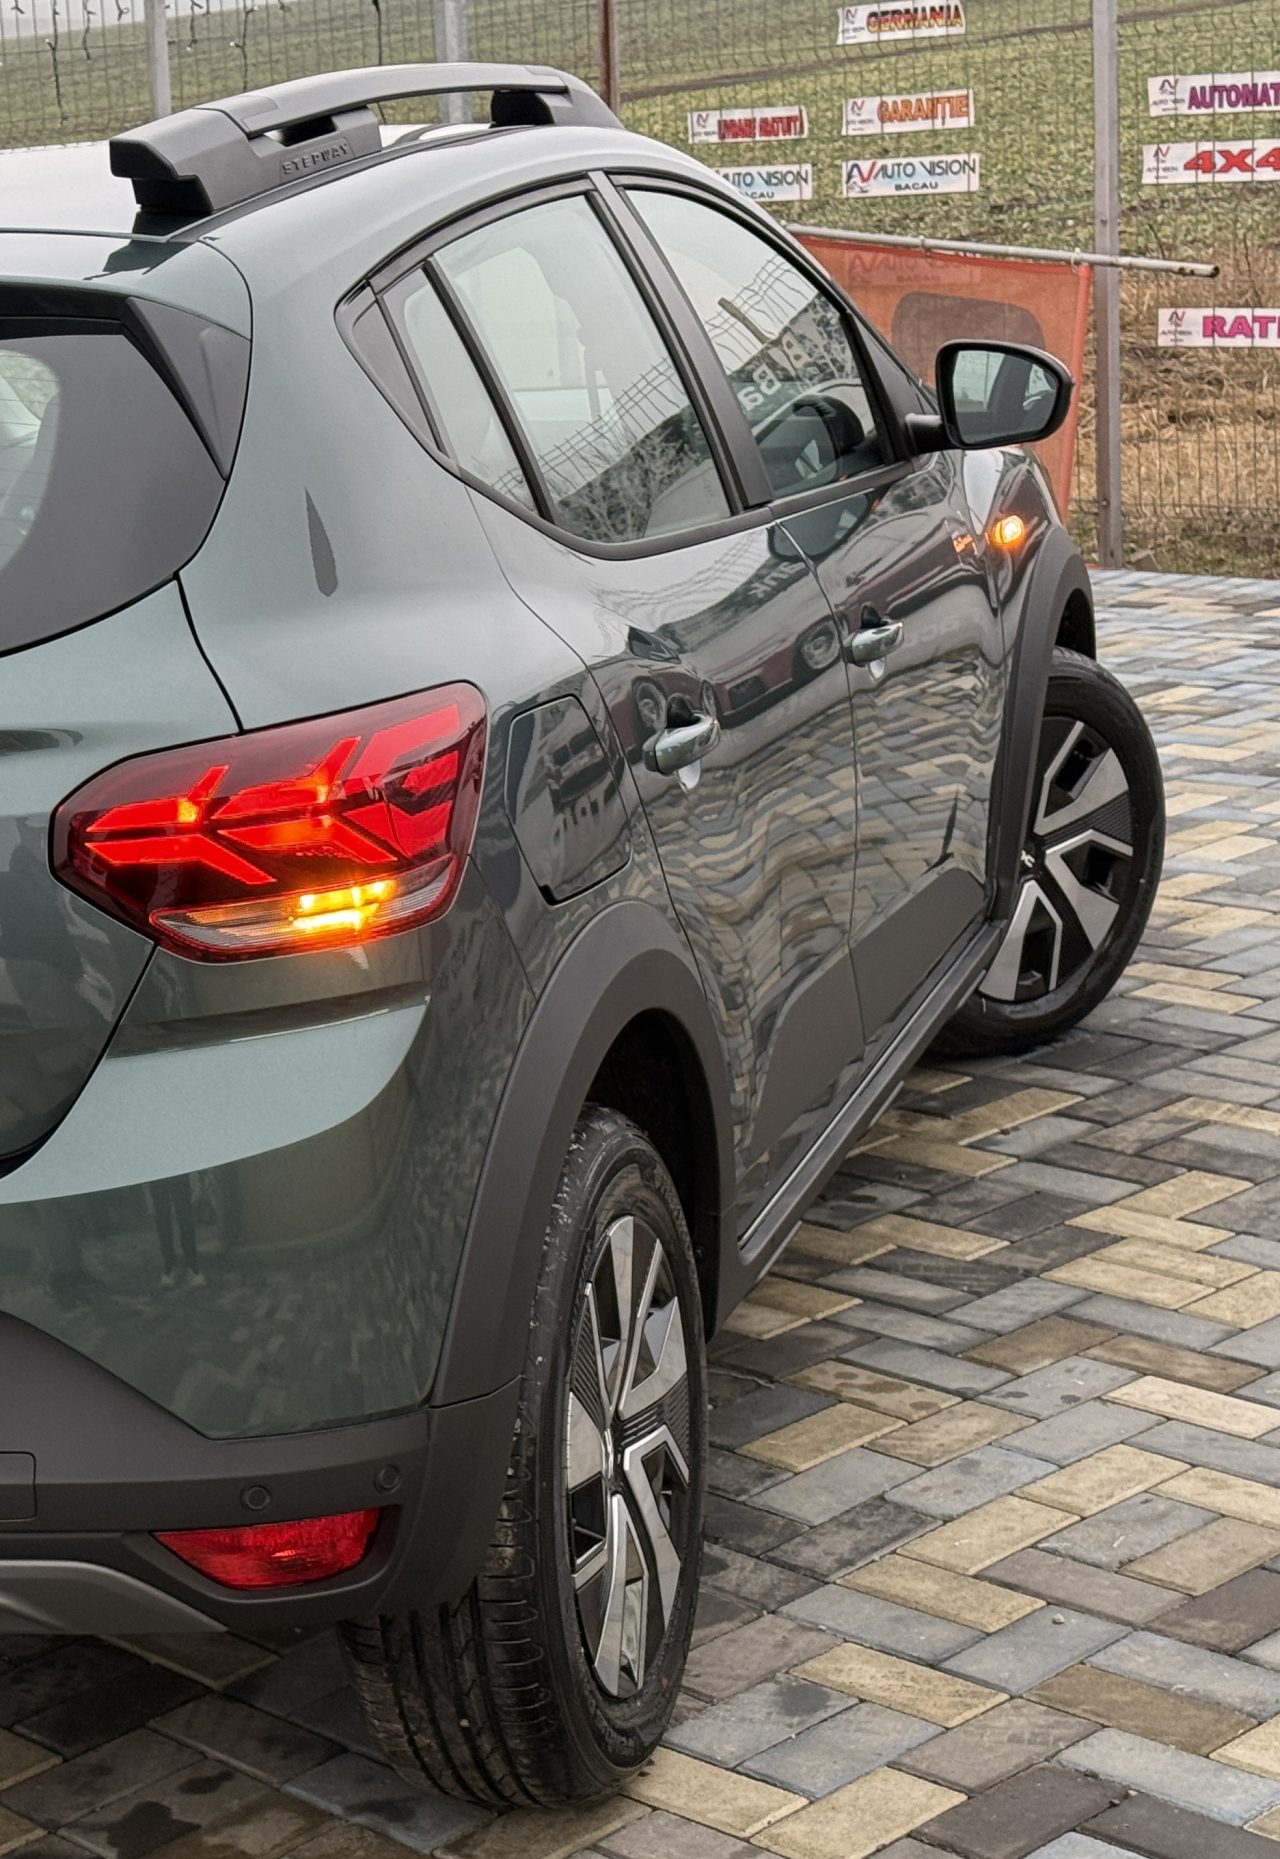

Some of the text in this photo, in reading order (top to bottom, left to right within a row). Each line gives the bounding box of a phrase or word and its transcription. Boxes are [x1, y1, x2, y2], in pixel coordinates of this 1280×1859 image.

[866, 4, 963, 34] GERMANIA
[756, 169, 809, 186] VISION
[872, 162, 916, 180] AUTO
[918, 158, 976, 176] VISION
[894, 181, 939, 191] BACAU
